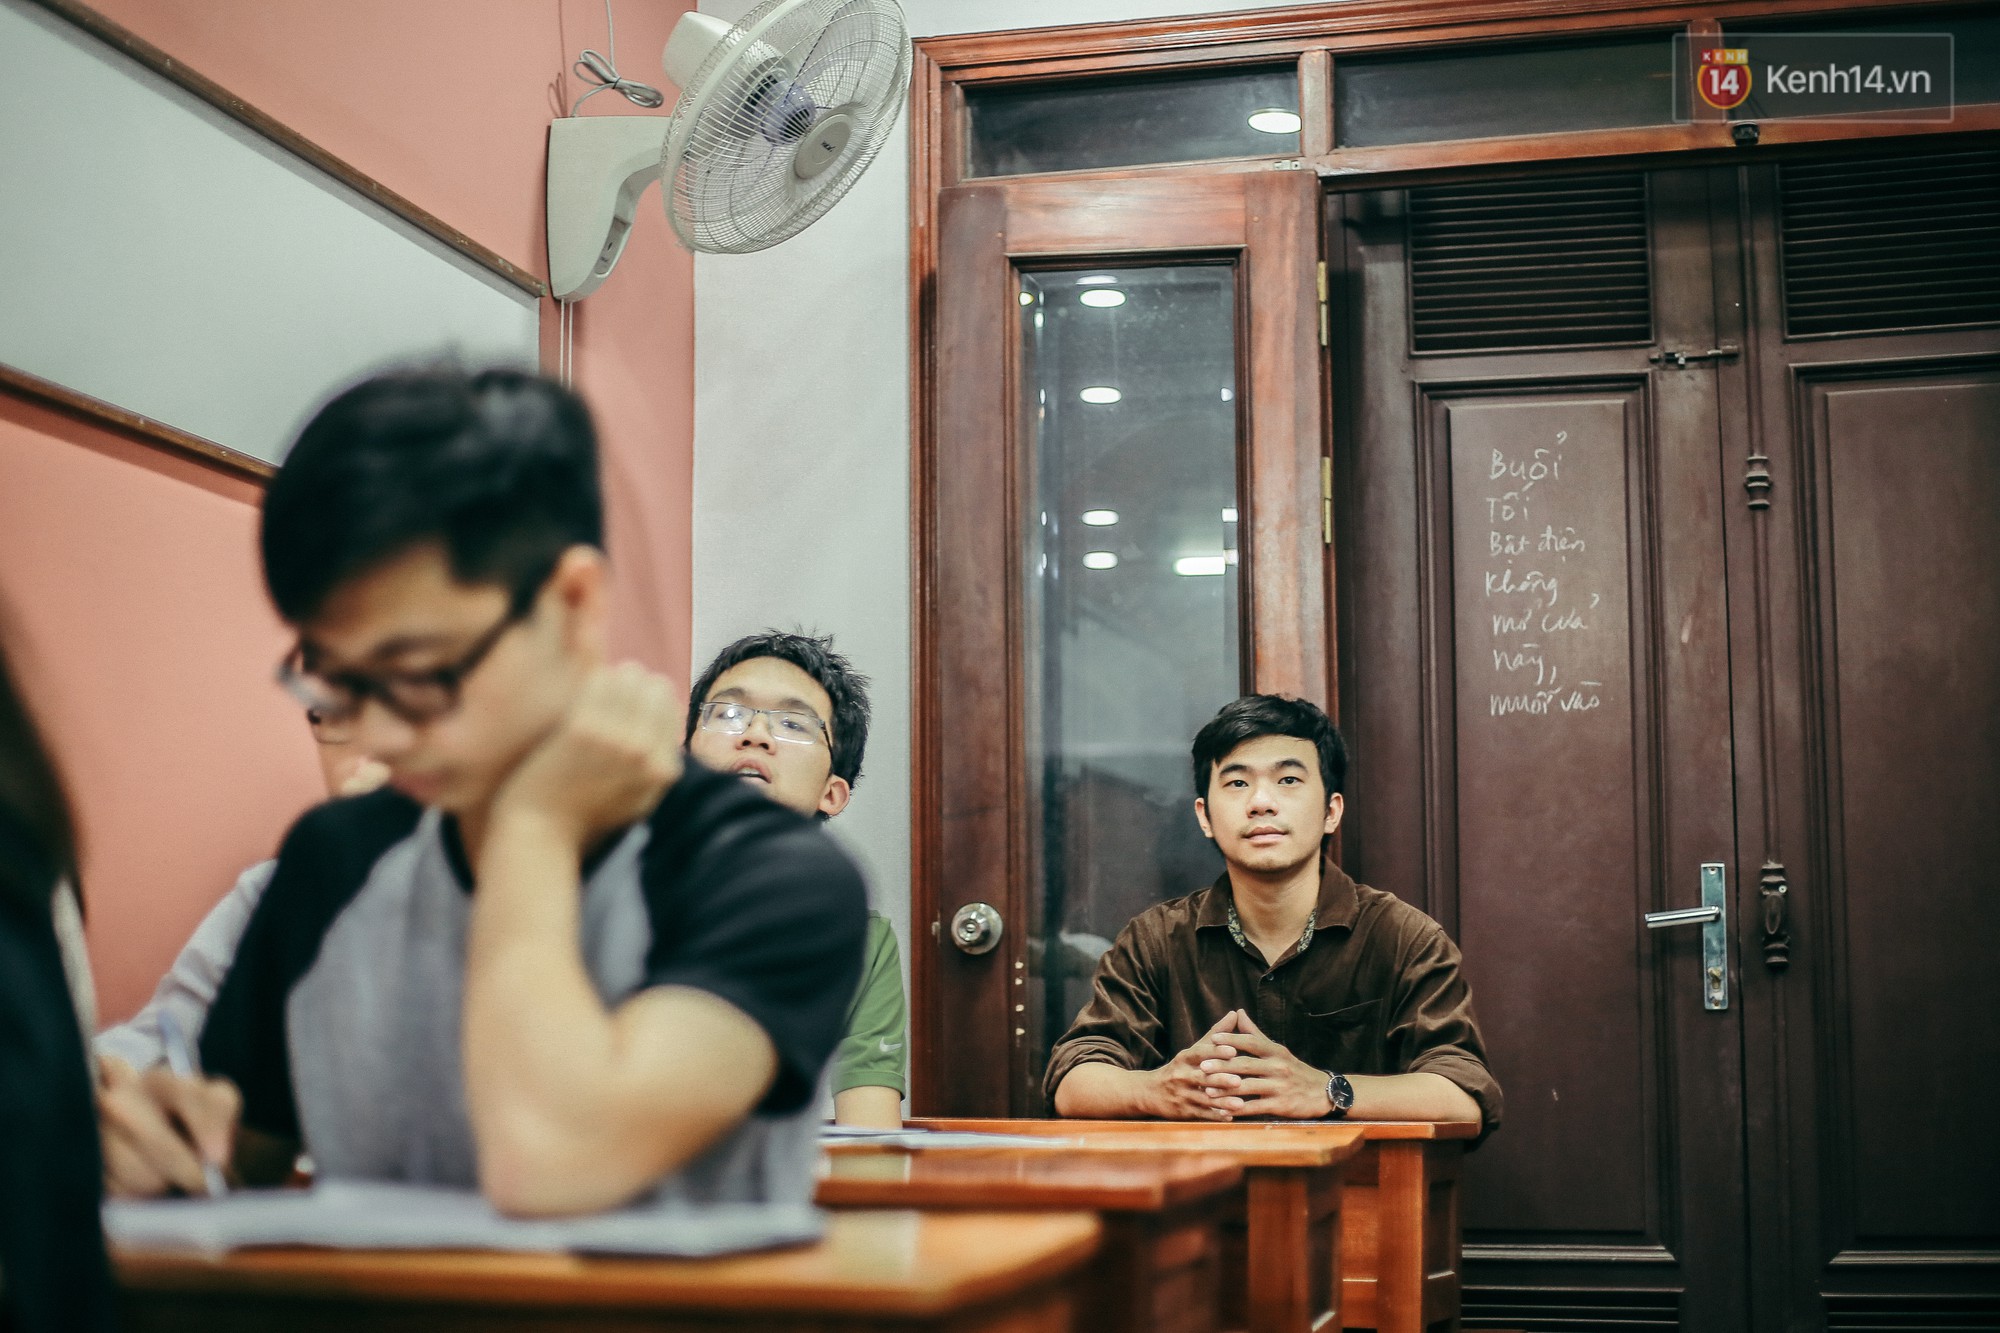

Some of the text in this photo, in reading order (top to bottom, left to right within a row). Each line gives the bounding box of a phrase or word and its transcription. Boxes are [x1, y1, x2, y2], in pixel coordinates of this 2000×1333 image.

[1489, 430, 1568, 480] Buổi
[1486, 481, 1535, 523] Tối
[1490, 531, 1530, 564] Bật
